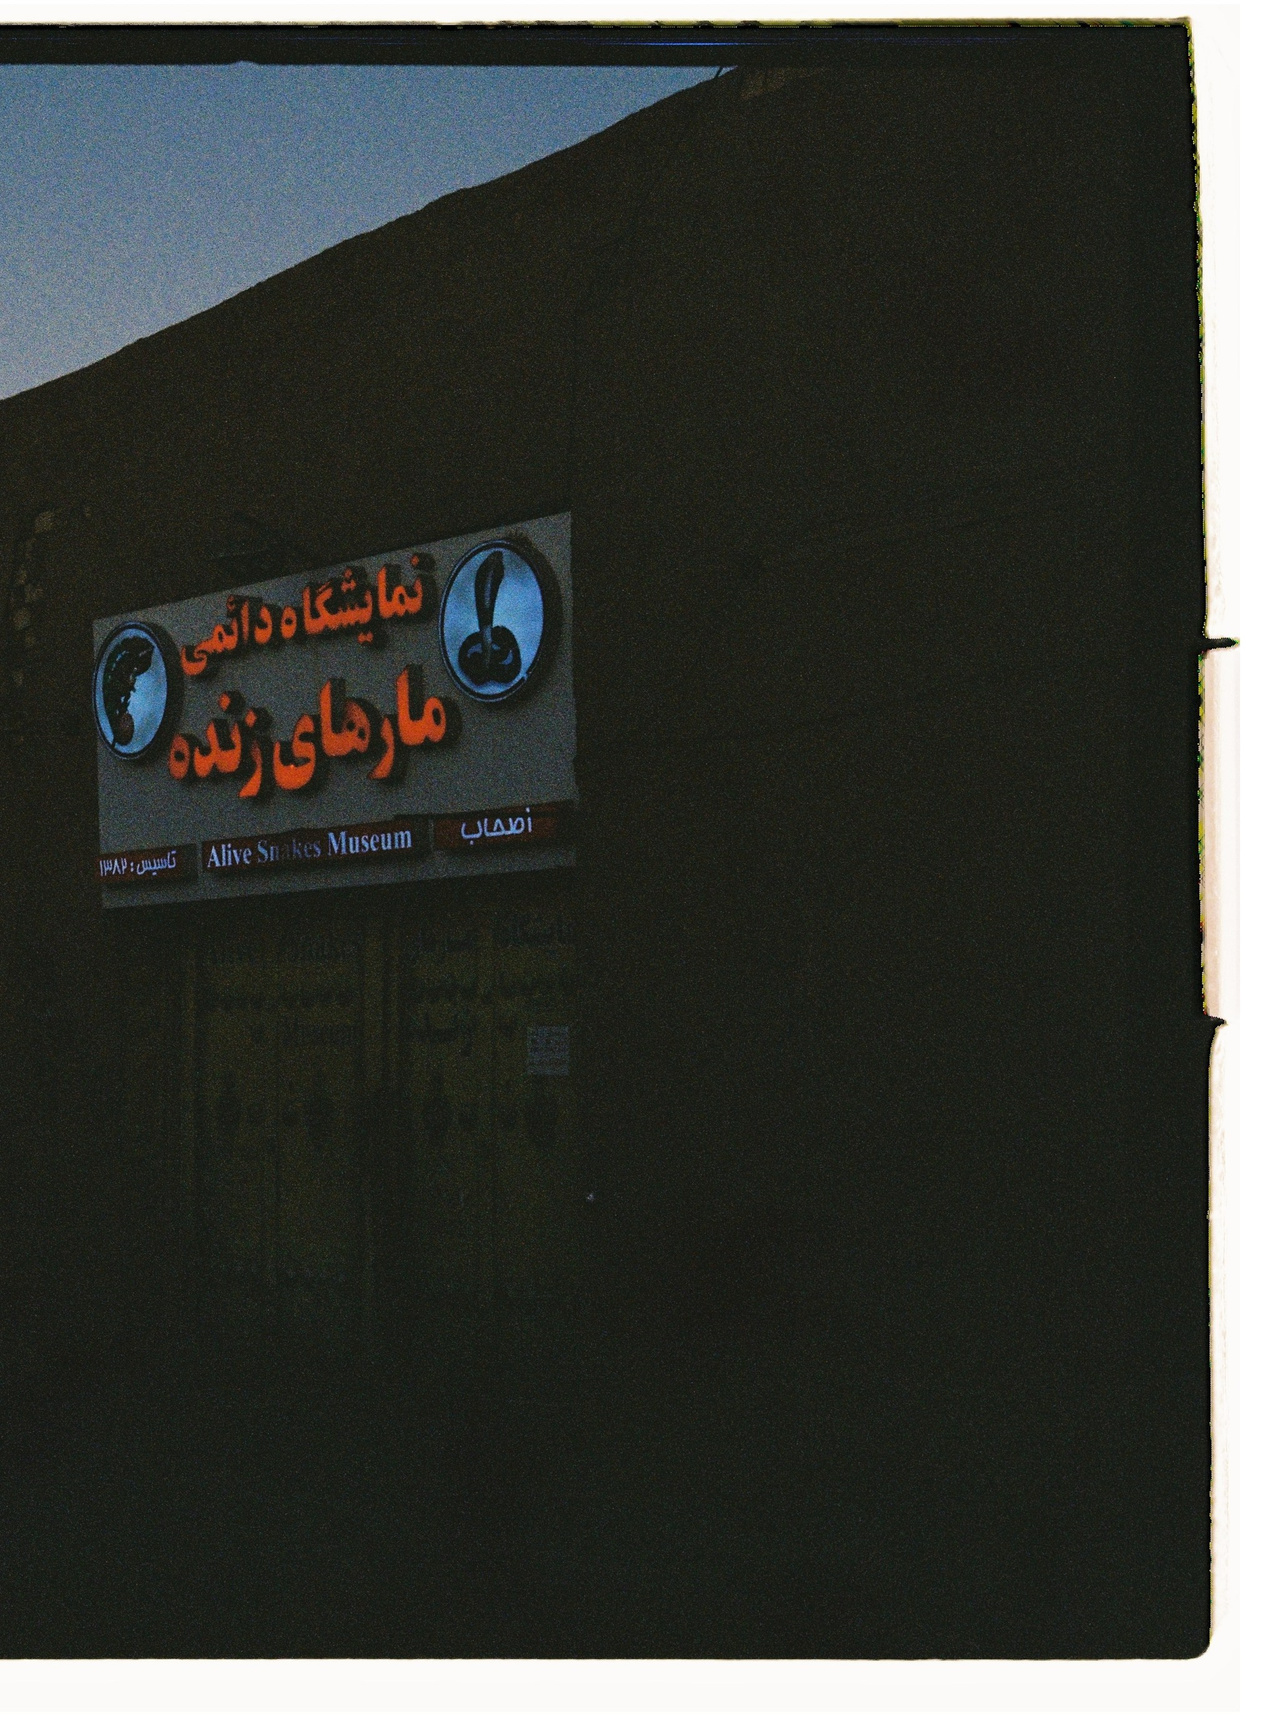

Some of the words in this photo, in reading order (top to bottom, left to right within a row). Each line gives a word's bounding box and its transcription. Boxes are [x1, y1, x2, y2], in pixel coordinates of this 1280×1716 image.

[279, 556, 424, 645] نمایشگاه
[167, 692, 264, 799] زنده
[271, 669, 447, 791] مارهای
[207, 842, 253, 869] Alive
[256, 837, 322, 864] Snakes
[326, 828, 413, 855] Museum
